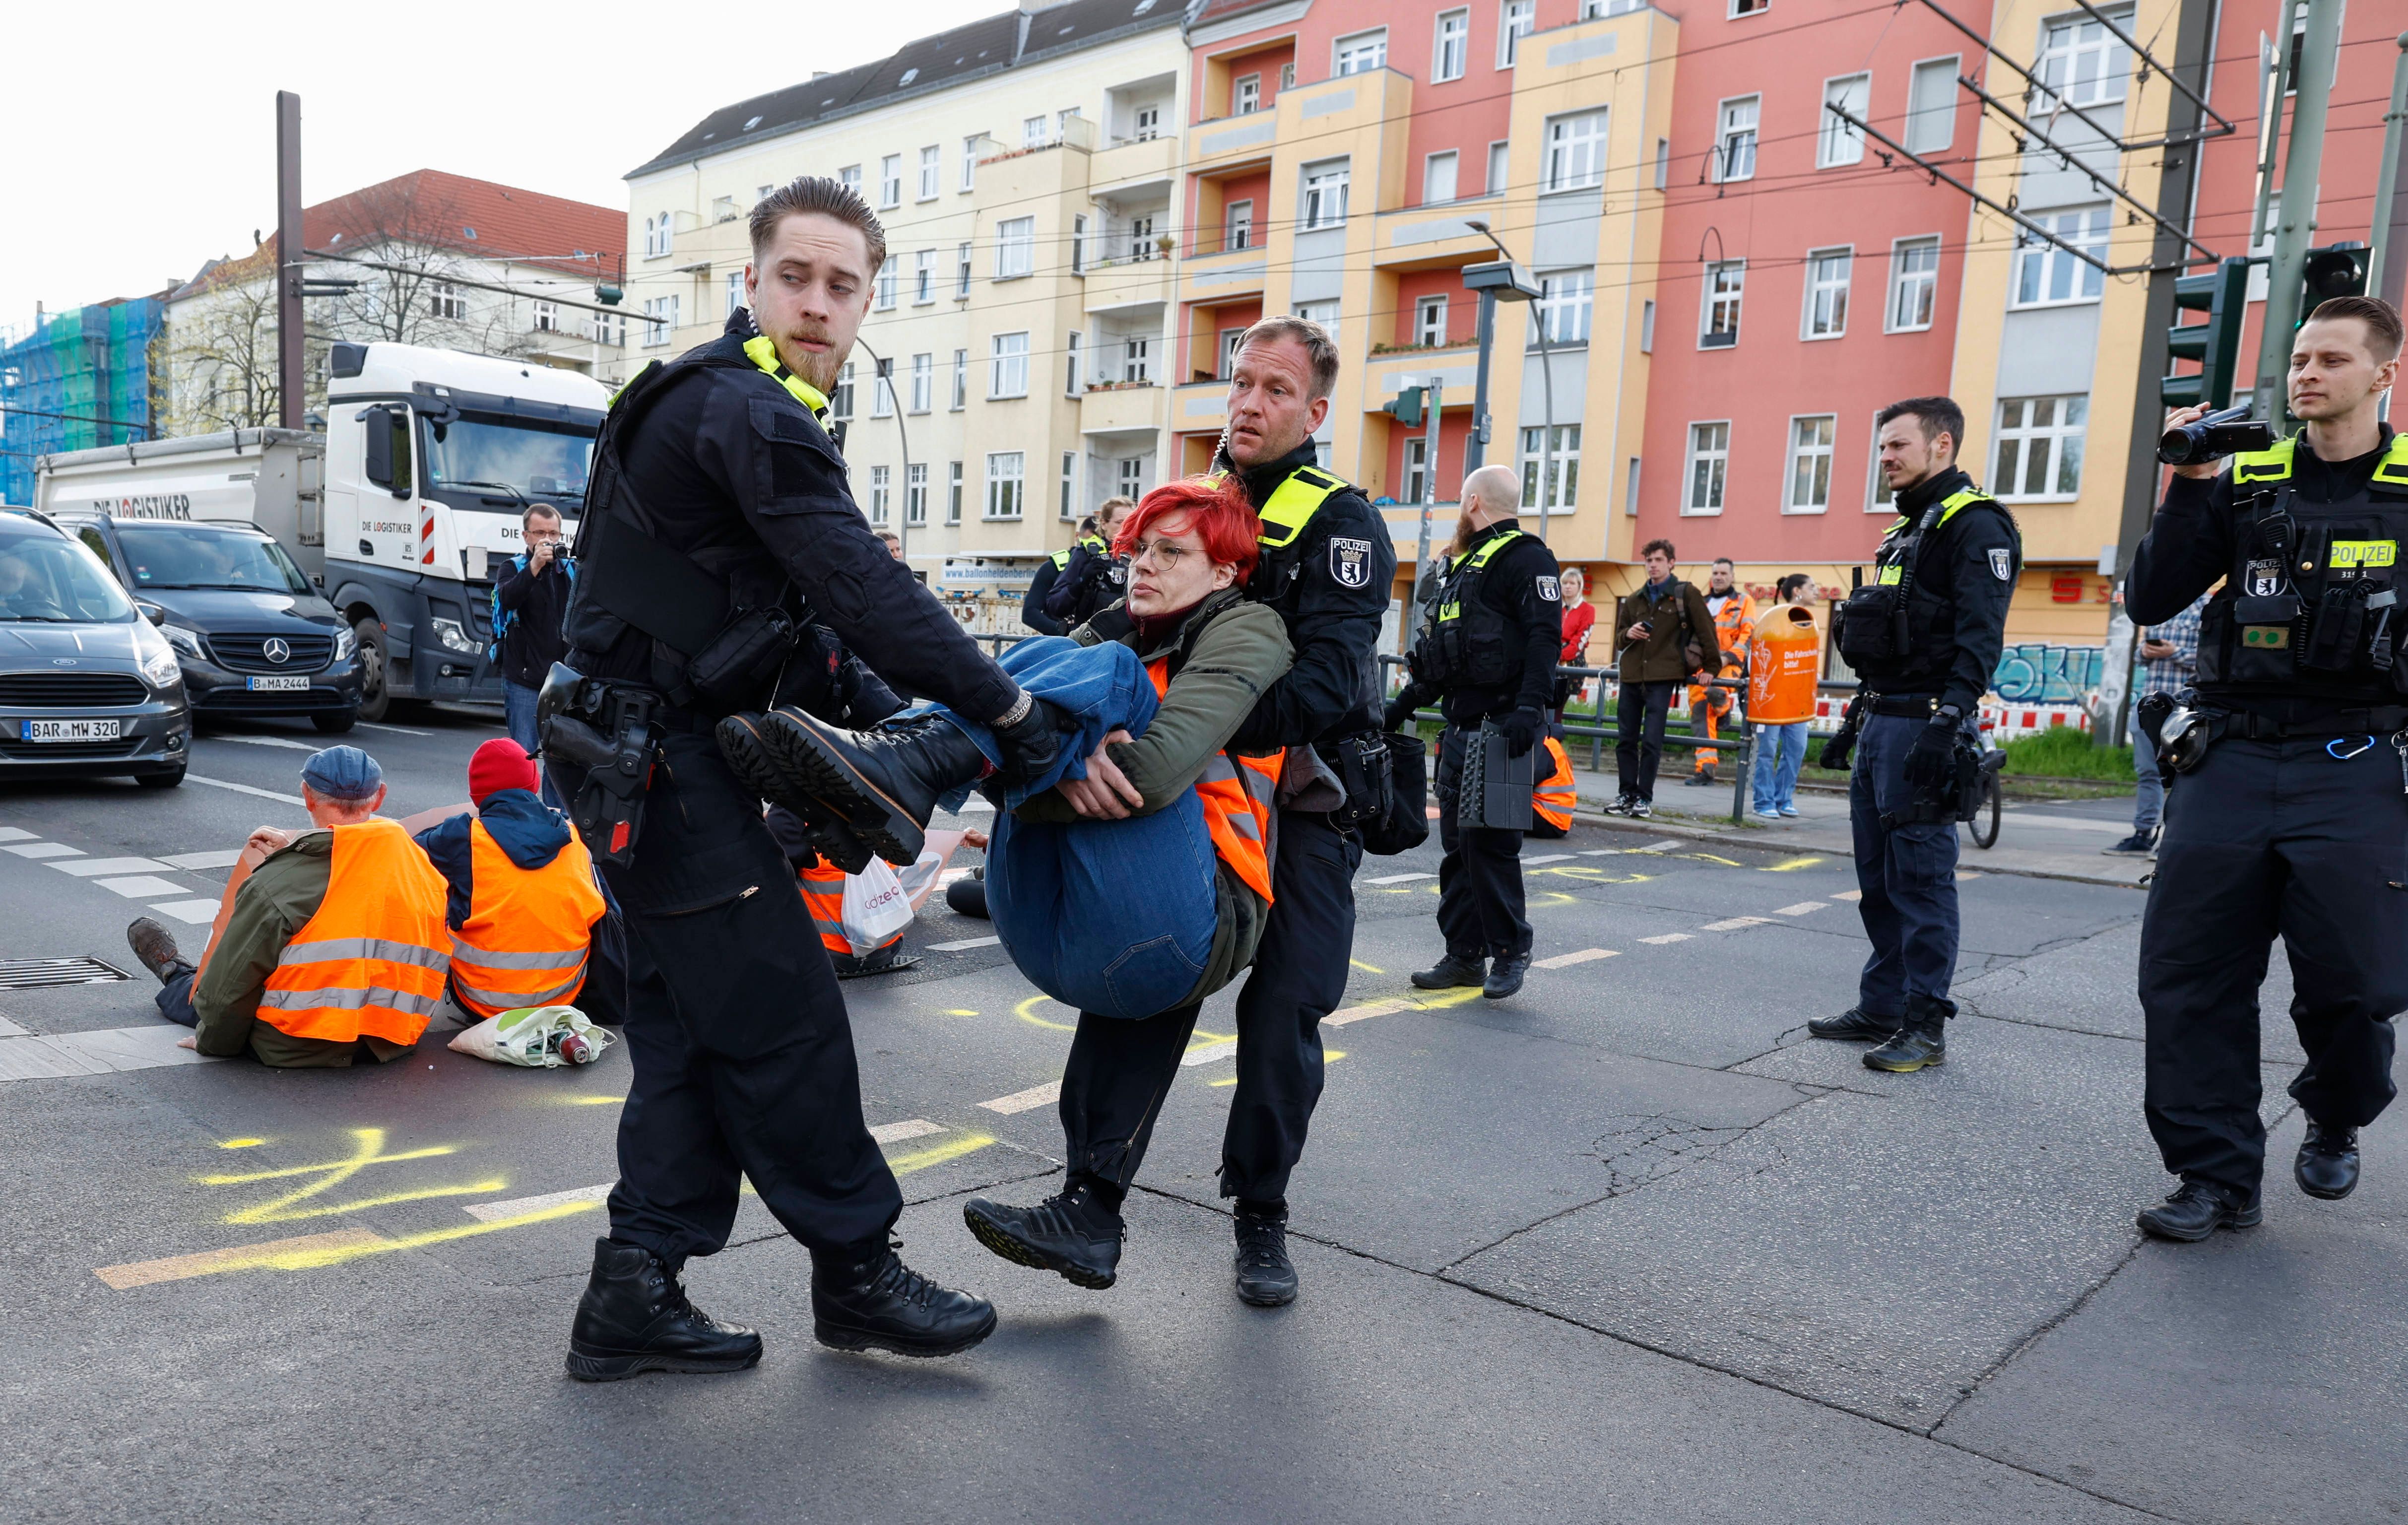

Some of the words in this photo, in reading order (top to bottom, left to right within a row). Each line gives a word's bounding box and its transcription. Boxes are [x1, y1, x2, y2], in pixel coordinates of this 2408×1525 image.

[362, 521, 371, 531] DIE
[374, 522, 412, 534] LOGISTIKER
[501, 528, 520, 539] DIE
[1333, 540, 1368, 552] POLIZEI
[2332, 546, 2392, 562] POLIZEI
[2250, 560, 2282, 570] POLIZ
[254, 679, 260, 689] B
[267, 679, 281, 689] MA
[283, 679, 308, 689] 2444
[32, 723, 60, 737] BAR
[71, 723, 89, 736] MW
[93, 722, 118, 736] 320
